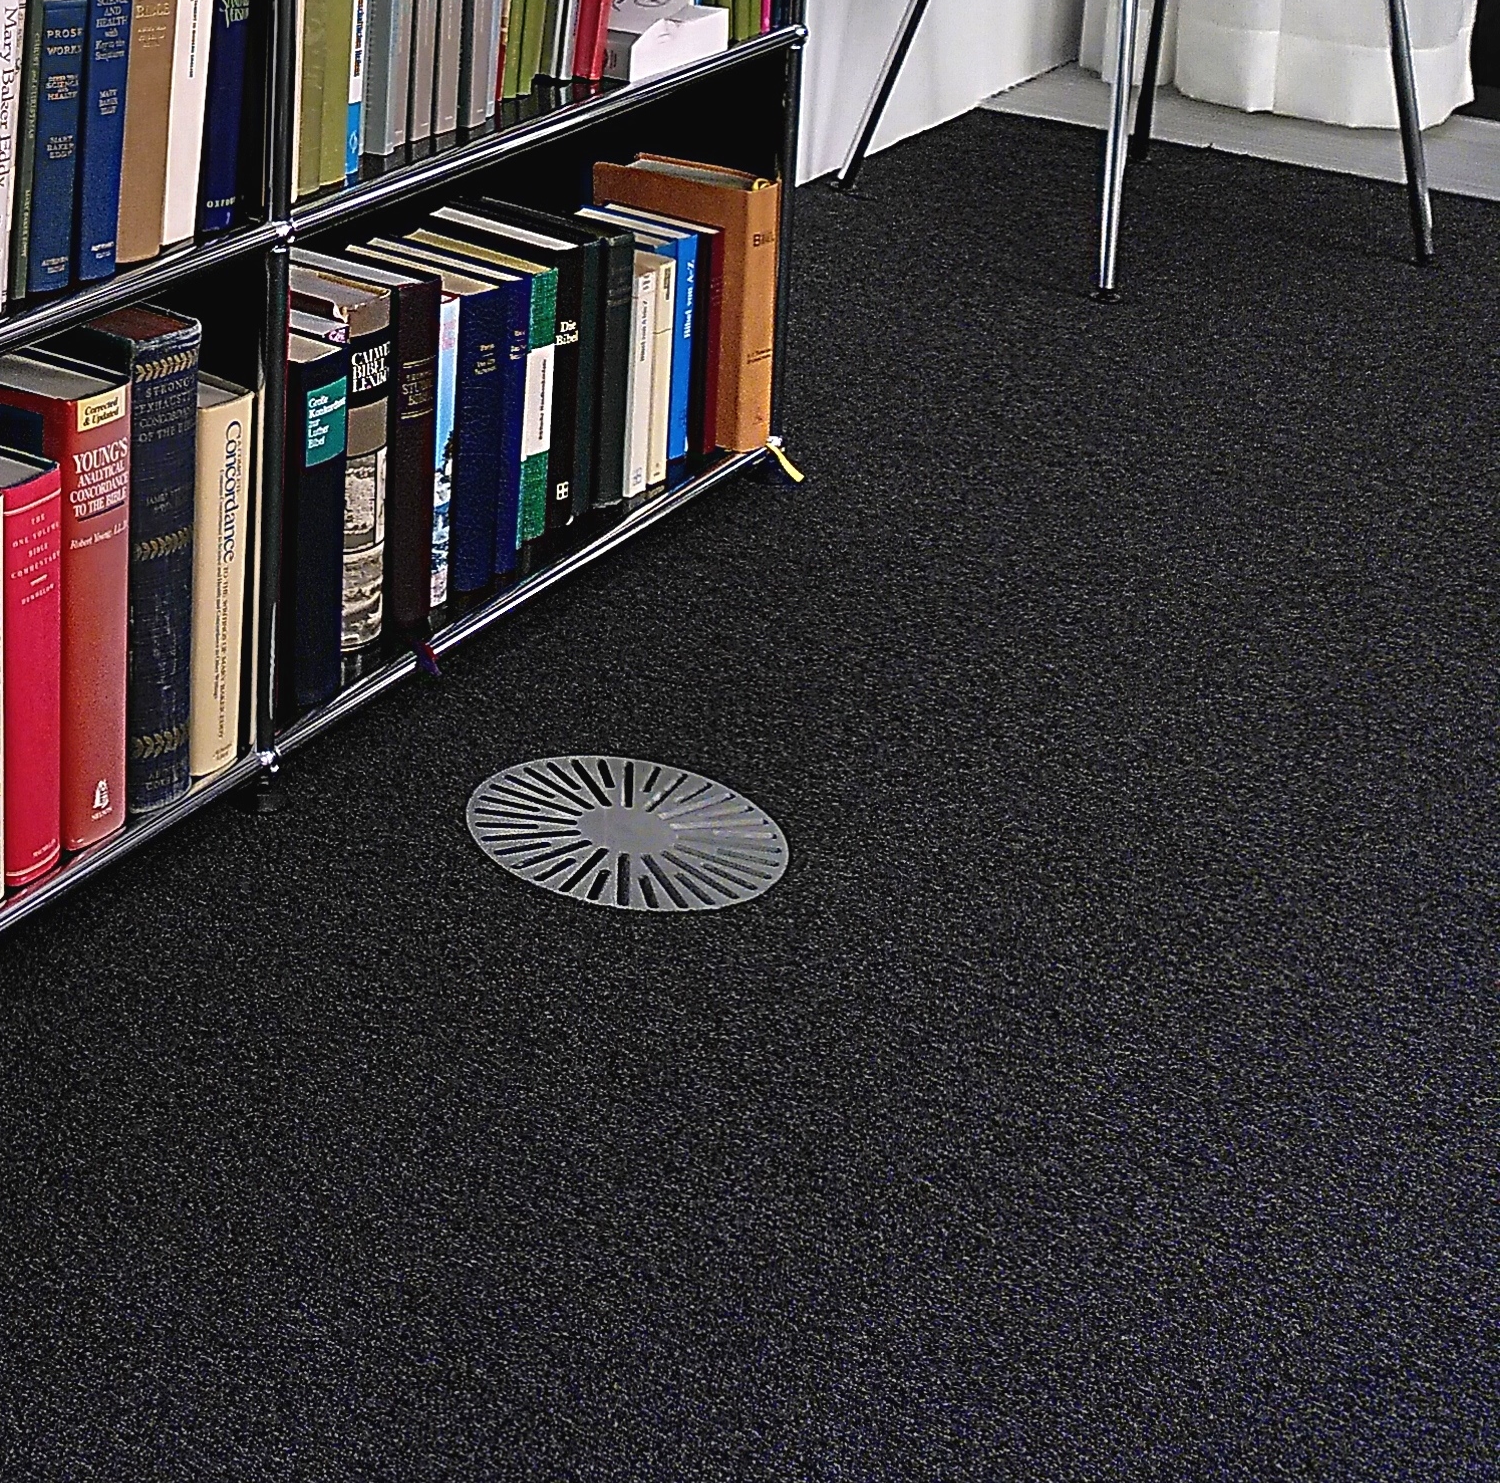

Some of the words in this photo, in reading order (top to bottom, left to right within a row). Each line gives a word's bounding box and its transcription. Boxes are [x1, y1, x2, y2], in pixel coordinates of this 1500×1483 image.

[105, 6, 122, 16] AND
[136, 3, 170, 19] BIBLE
[96, 16, 127, 29] HEALTH
[47, 46, 82, 56] WORKS
[0, 67, 16, 129] Baker
[559, 320, 577, 334] Die
[556, 331, 579, 346] Bibel
[352, 341, 390, 366] CALWE
[85, 397, 118, 416] Corrected
[83, 416, 91, 427] &
[92, 408, 119, 423] Updated
[73, 437, 128, 475] YOUNG'S
[78, 461, 125, 488] ANALYTICAL
[70, 473, 129, 505] CONCORDANCE
[223, 420, 242, 563] Concordance
[74, 504, 87, 518] TO
[88, 497, 105, 513] THE
[106, 486, 127, 507] BIBLE
[70, 535, 93, 549] Robert
